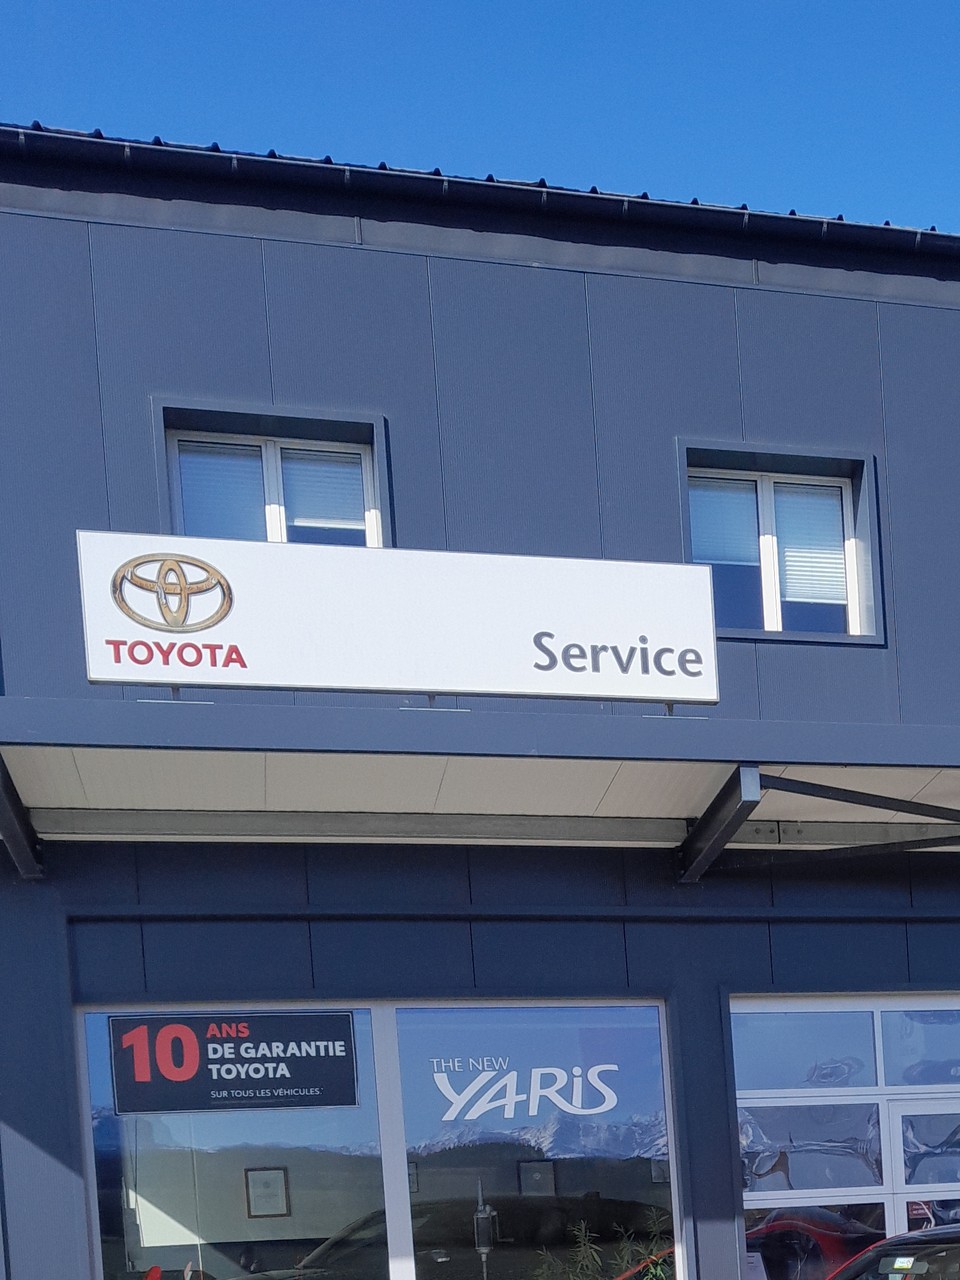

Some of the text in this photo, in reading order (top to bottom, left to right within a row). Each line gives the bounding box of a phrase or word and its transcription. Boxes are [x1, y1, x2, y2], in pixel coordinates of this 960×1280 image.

[105, 639, 248, 669] TOYOTA
[532, 631, 704, 678] Service
[206, 1022, 250, 1039] ANS
[122, 1023, 200, 1083] 10
[207, 1040, 346, 1059] DE GARANTIE
[208, 1063, 291, 1080] TOYOTA
[430, 1056, 510, 1072] THE NEW
[210, 1090, 229, 1098] SUR
[230, 1089, 254, 1097] TOUS
[256, 1088, 271, 1097] LES
